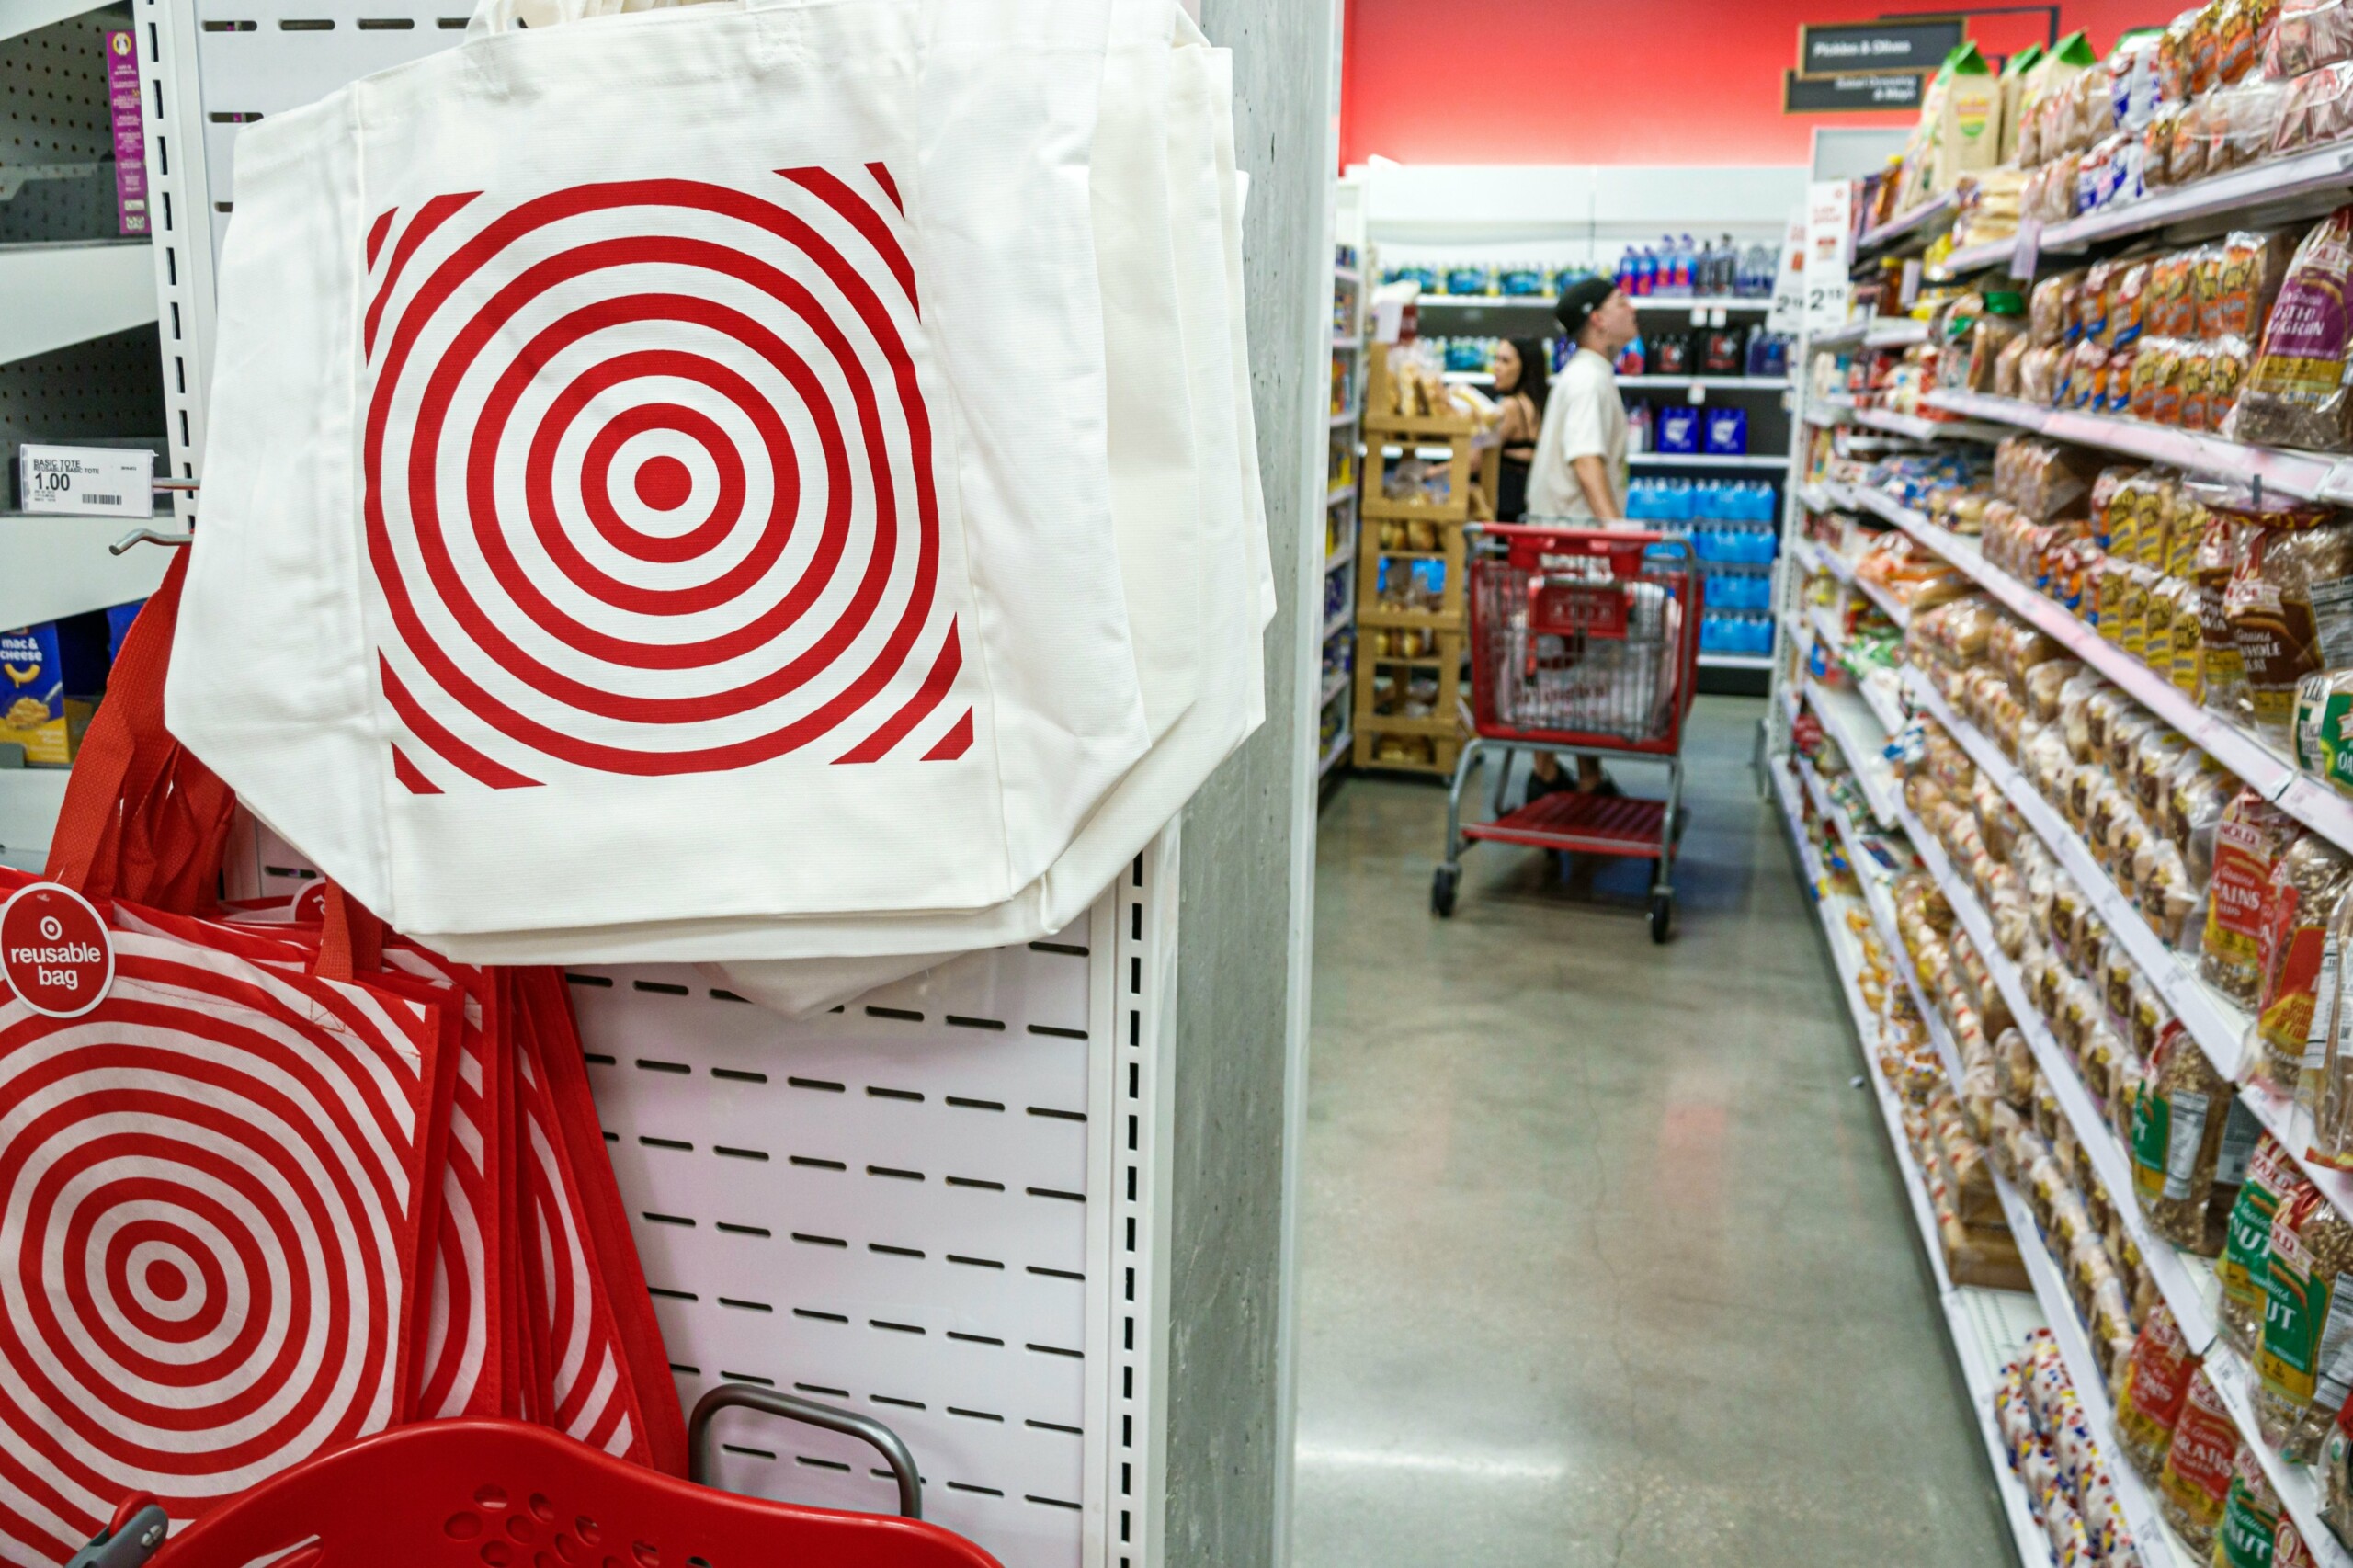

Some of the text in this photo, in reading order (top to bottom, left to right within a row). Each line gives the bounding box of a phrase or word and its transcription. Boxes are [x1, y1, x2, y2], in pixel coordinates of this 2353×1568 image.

[1811, 290, 1825, 310] 2
[34, 459, 80, 469] BASIC TOTE
[34, 464, 63, 472] REUSABLE
[35, 472, 71, 491] 1.00
[1, 637, 39, 650] mac &
[11, 942, 101, 963] reusable
[38, 965, 78, 990] bag
